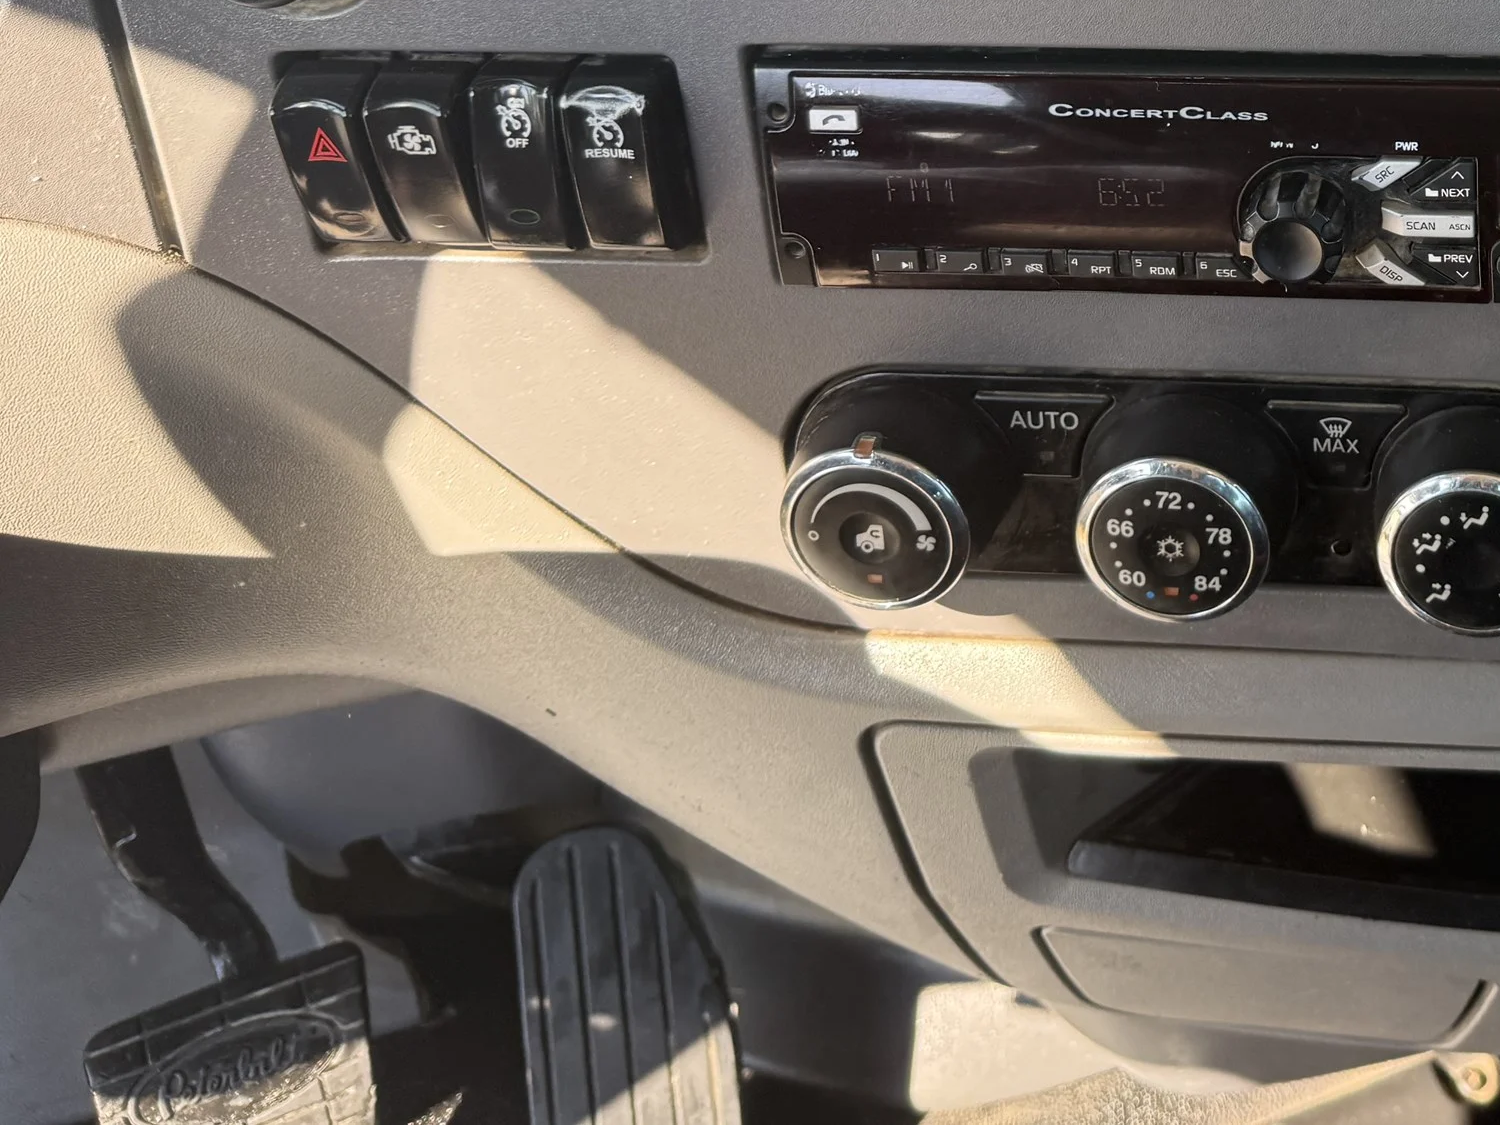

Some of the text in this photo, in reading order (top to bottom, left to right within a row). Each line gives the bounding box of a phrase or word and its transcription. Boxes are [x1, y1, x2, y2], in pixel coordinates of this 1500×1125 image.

[505, 137, 530, 148] OFF
[1395, 141, 1418, 151] PWR
[585, 148, 636, 160] RESUME
[1374, 165, 1395, 183] SRC
[1440, 188, 1471, 198] NEXT
[1405, 221, 1436, 231] SCAN
[875, 253, 880, 262] 1
[939, 254, 947, 264] 2
[1004, 257, 1013, 266] 3
[1071, 258, 1079, 267] 4
[1443, 254, 1474, 264] PREV
[1134, 259, 1143, 268] 5
[1200, 261, 1208, 271] 6
[1090, 266, 1112, 275] RPT
[1150, 266, 1176, 276] RDM
[1216, 269, 1237, 278] ESC
[1379, 265, 1403, 283] DISP
[1010, 410, 1079, 431] AUTO
[1312, 438, 1360, 455] MAX
[1154, 491, 1182, 511] 72
[1106, 518, 1134, 538] 66
[1205, 527, 1232, 546] 78
[1118, 569, 1146, 588] 60
[1194, 575, 1222, 593] 84
